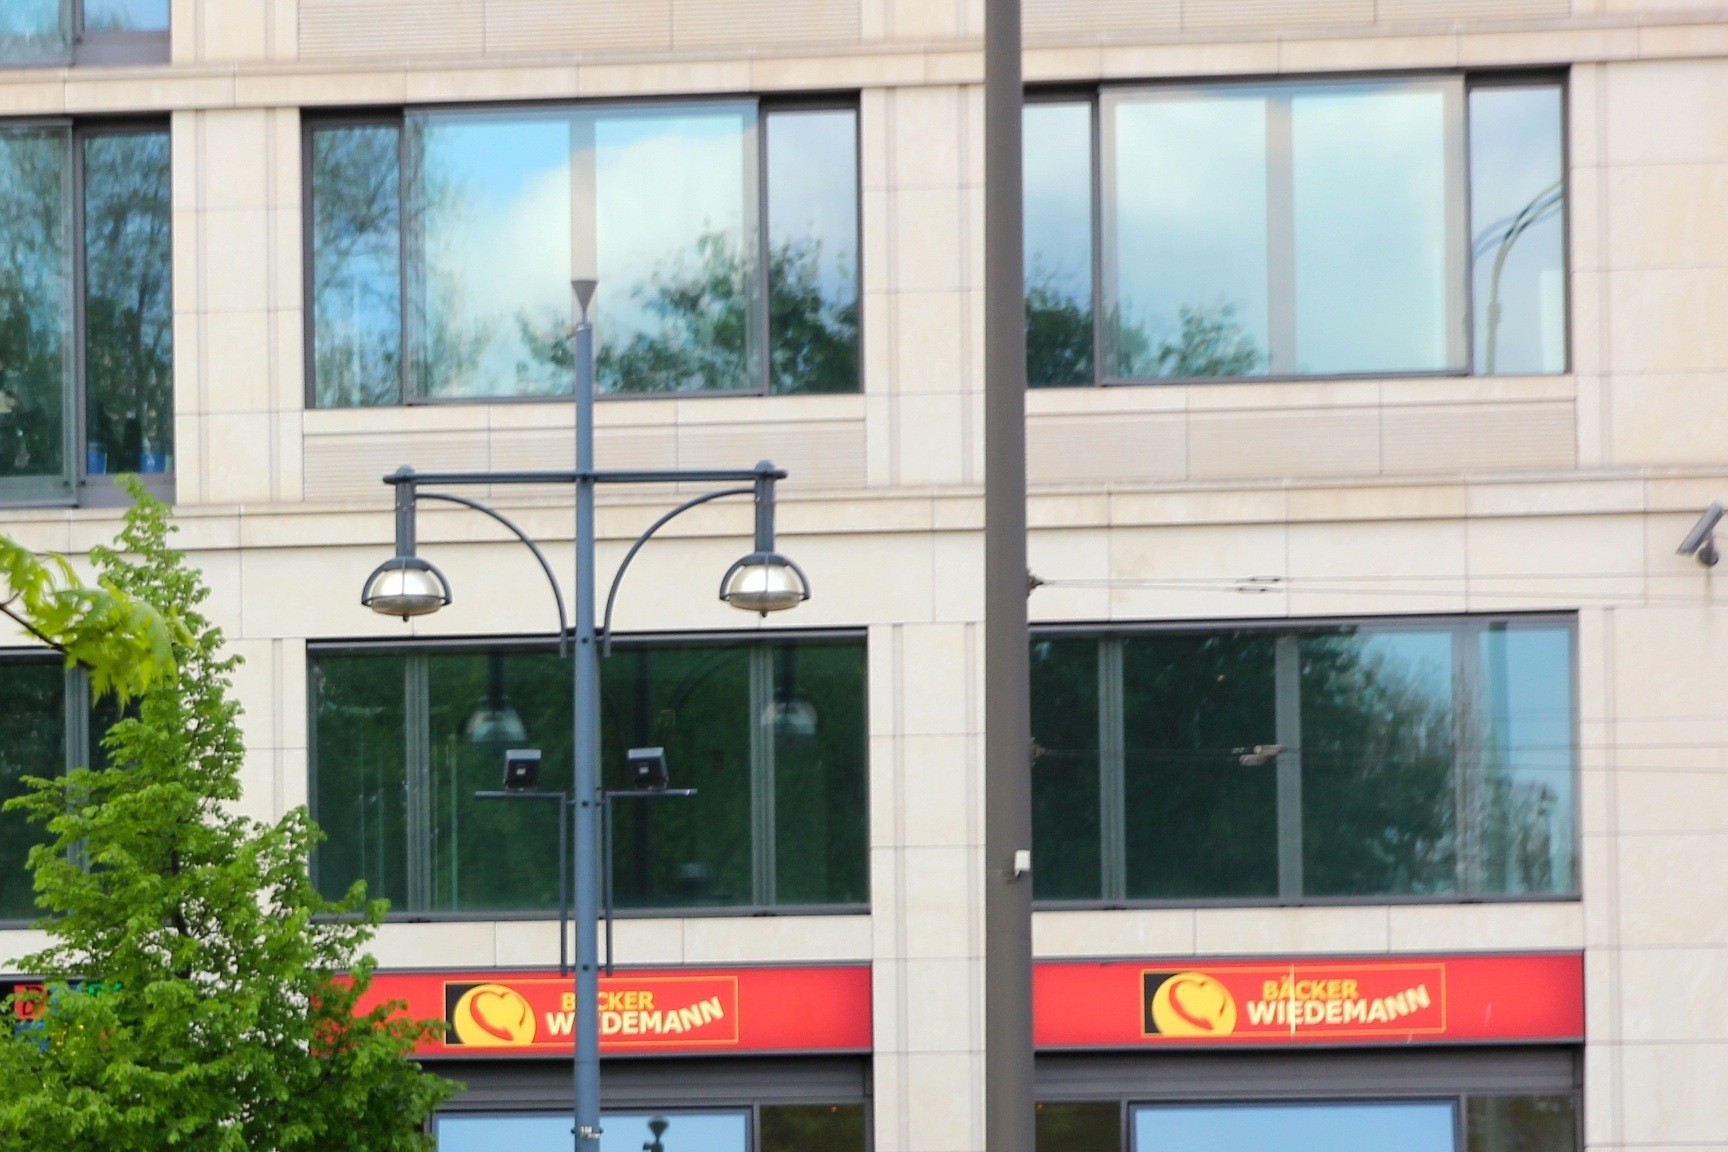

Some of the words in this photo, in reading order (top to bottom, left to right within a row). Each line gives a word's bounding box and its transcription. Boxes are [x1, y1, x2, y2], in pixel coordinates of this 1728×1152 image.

[562, 991, 654, 1011] BCKER
[1263, 975, 1359, 1000] BÄCKER
[546, 996, 724, 1035] WDEMANN
[1247, 984, 1431, 1025] WIEDEMANN
